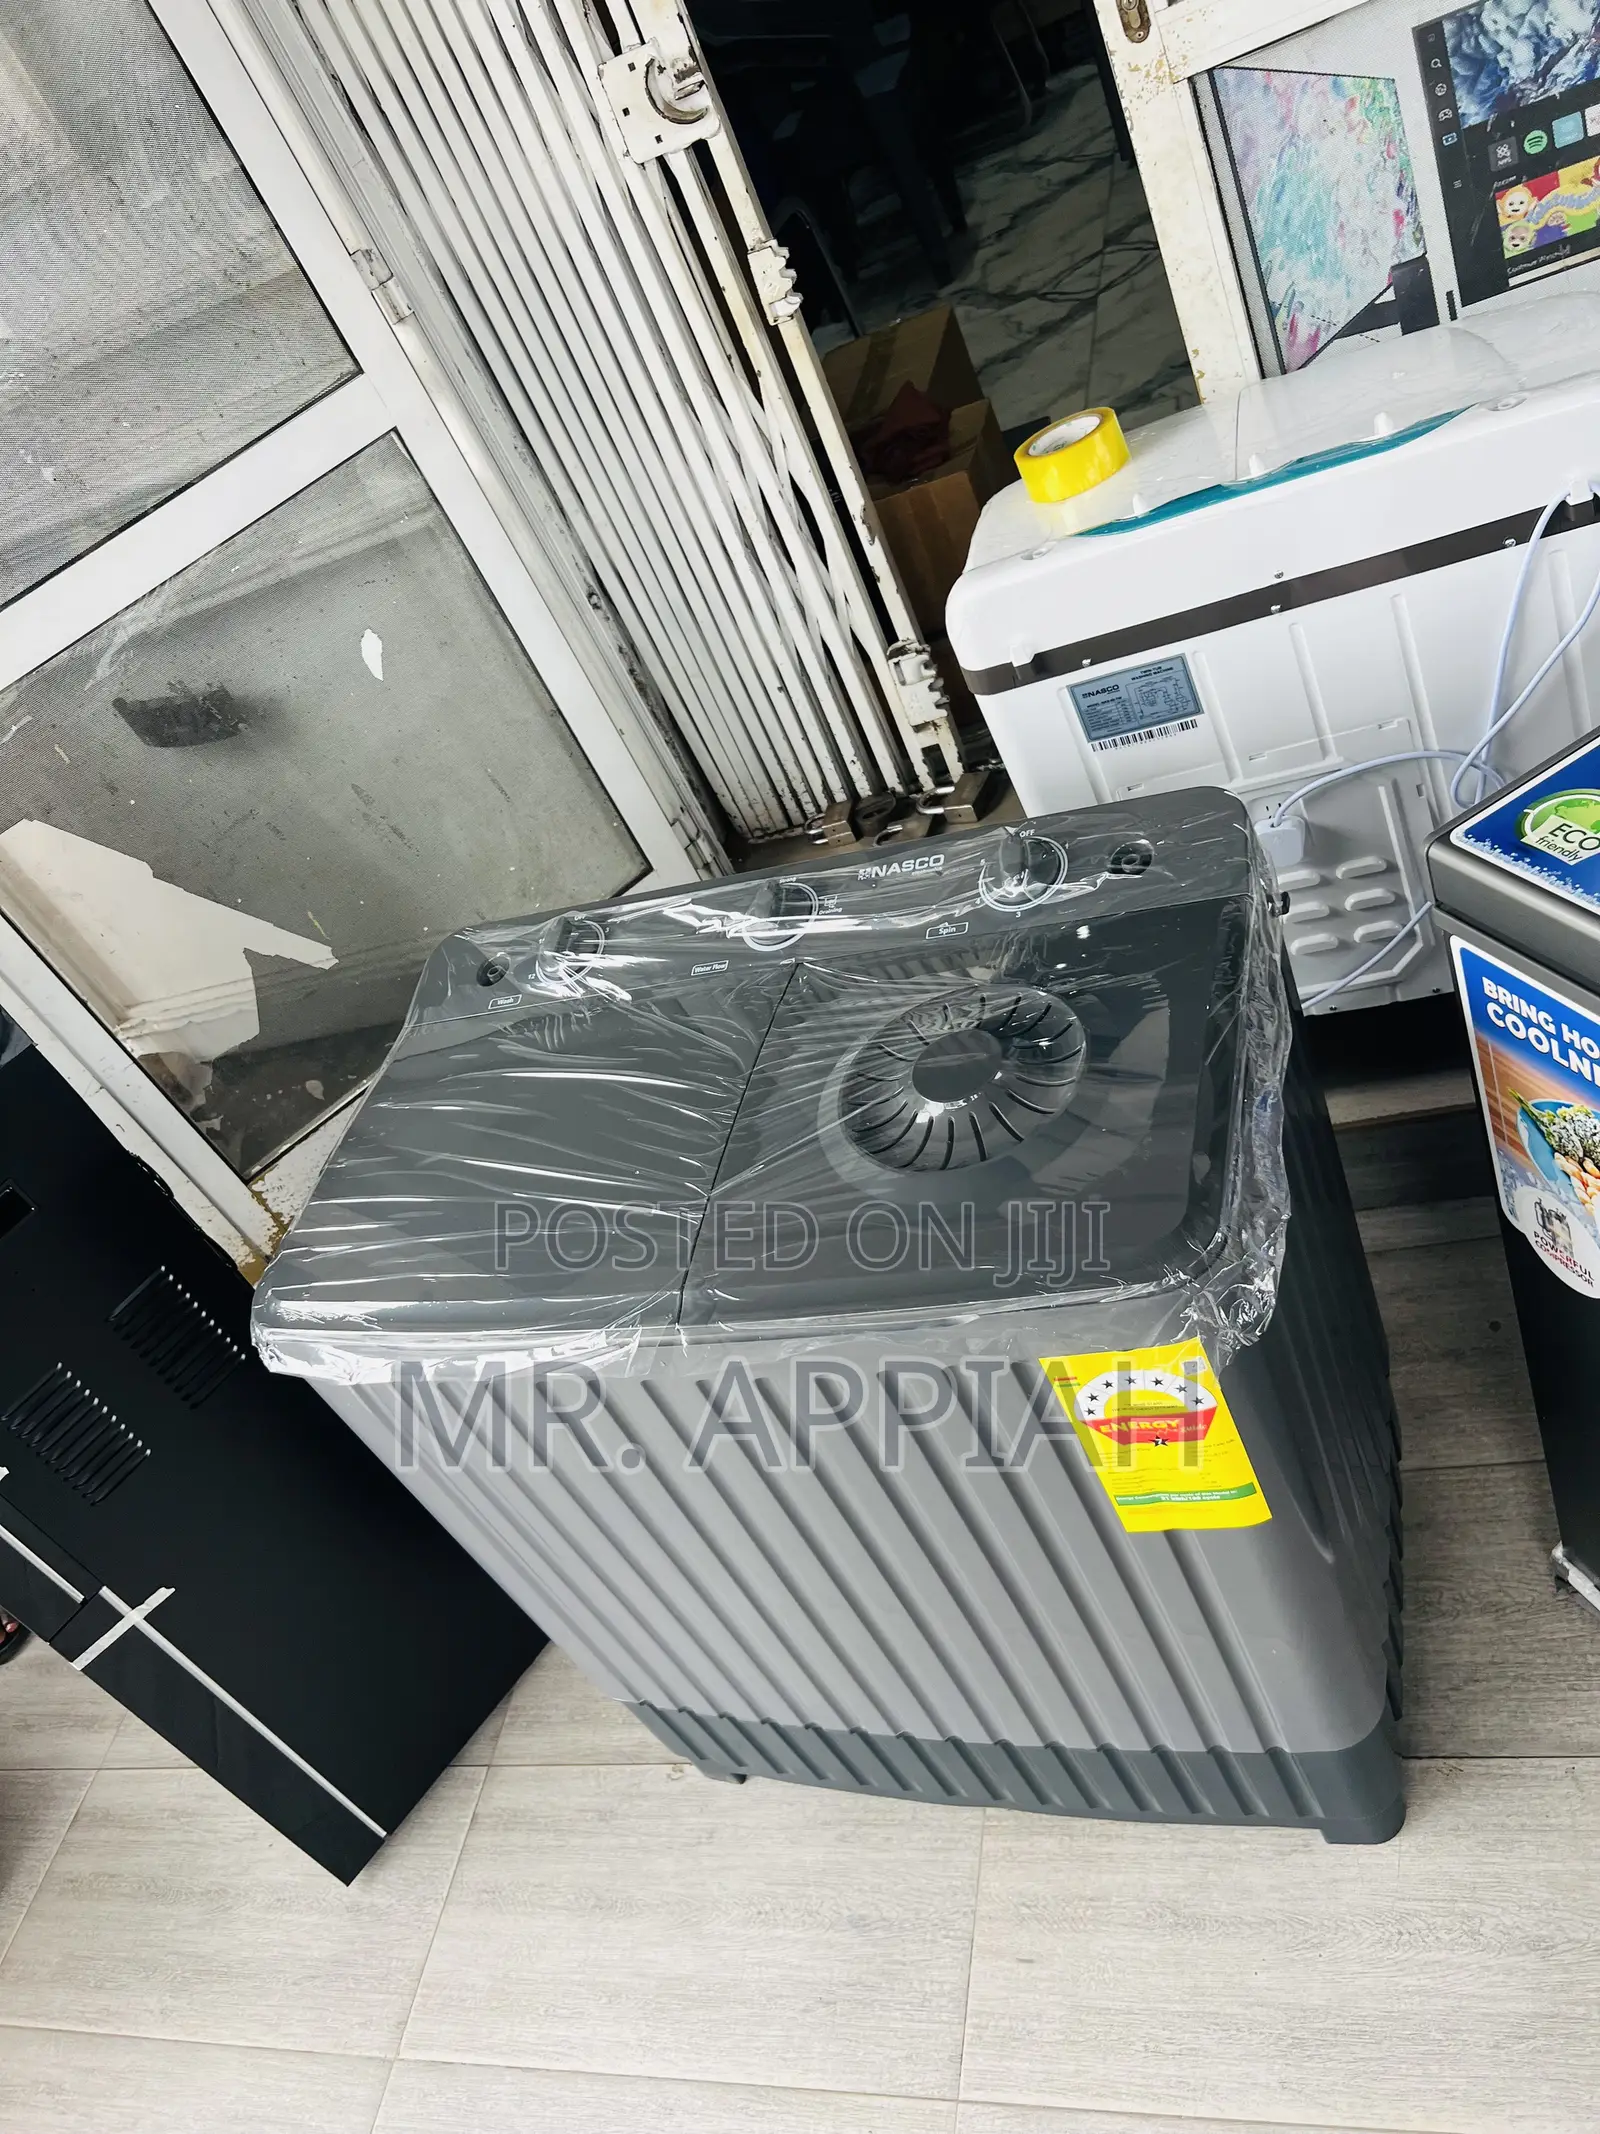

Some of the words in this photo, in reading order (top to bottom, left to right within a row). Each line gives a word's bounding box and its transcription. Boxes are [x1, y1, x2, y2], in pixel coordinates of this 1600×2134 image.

[1087, 684, 1120, 698] NASCO
[1019, 829, 1035, 838] OFF
[1548, 823, 1600, 851] ECO
[1535, 836, 1583, 863] friendly
[870, 853, 945, 878] NASCO
[939, 925, 956, 935] Spin
[694, 964, 712, 973] Water
[497, 997, 514, 1005] Wash
[1482, 976, 1557, 1035] BRING
[1533, 1231, 1594, 1282] POWERFUL
[1535, 1240, 1594, 1288] COMPRESSOR
[1099, 1419, 1181, 1434] ENERGY
